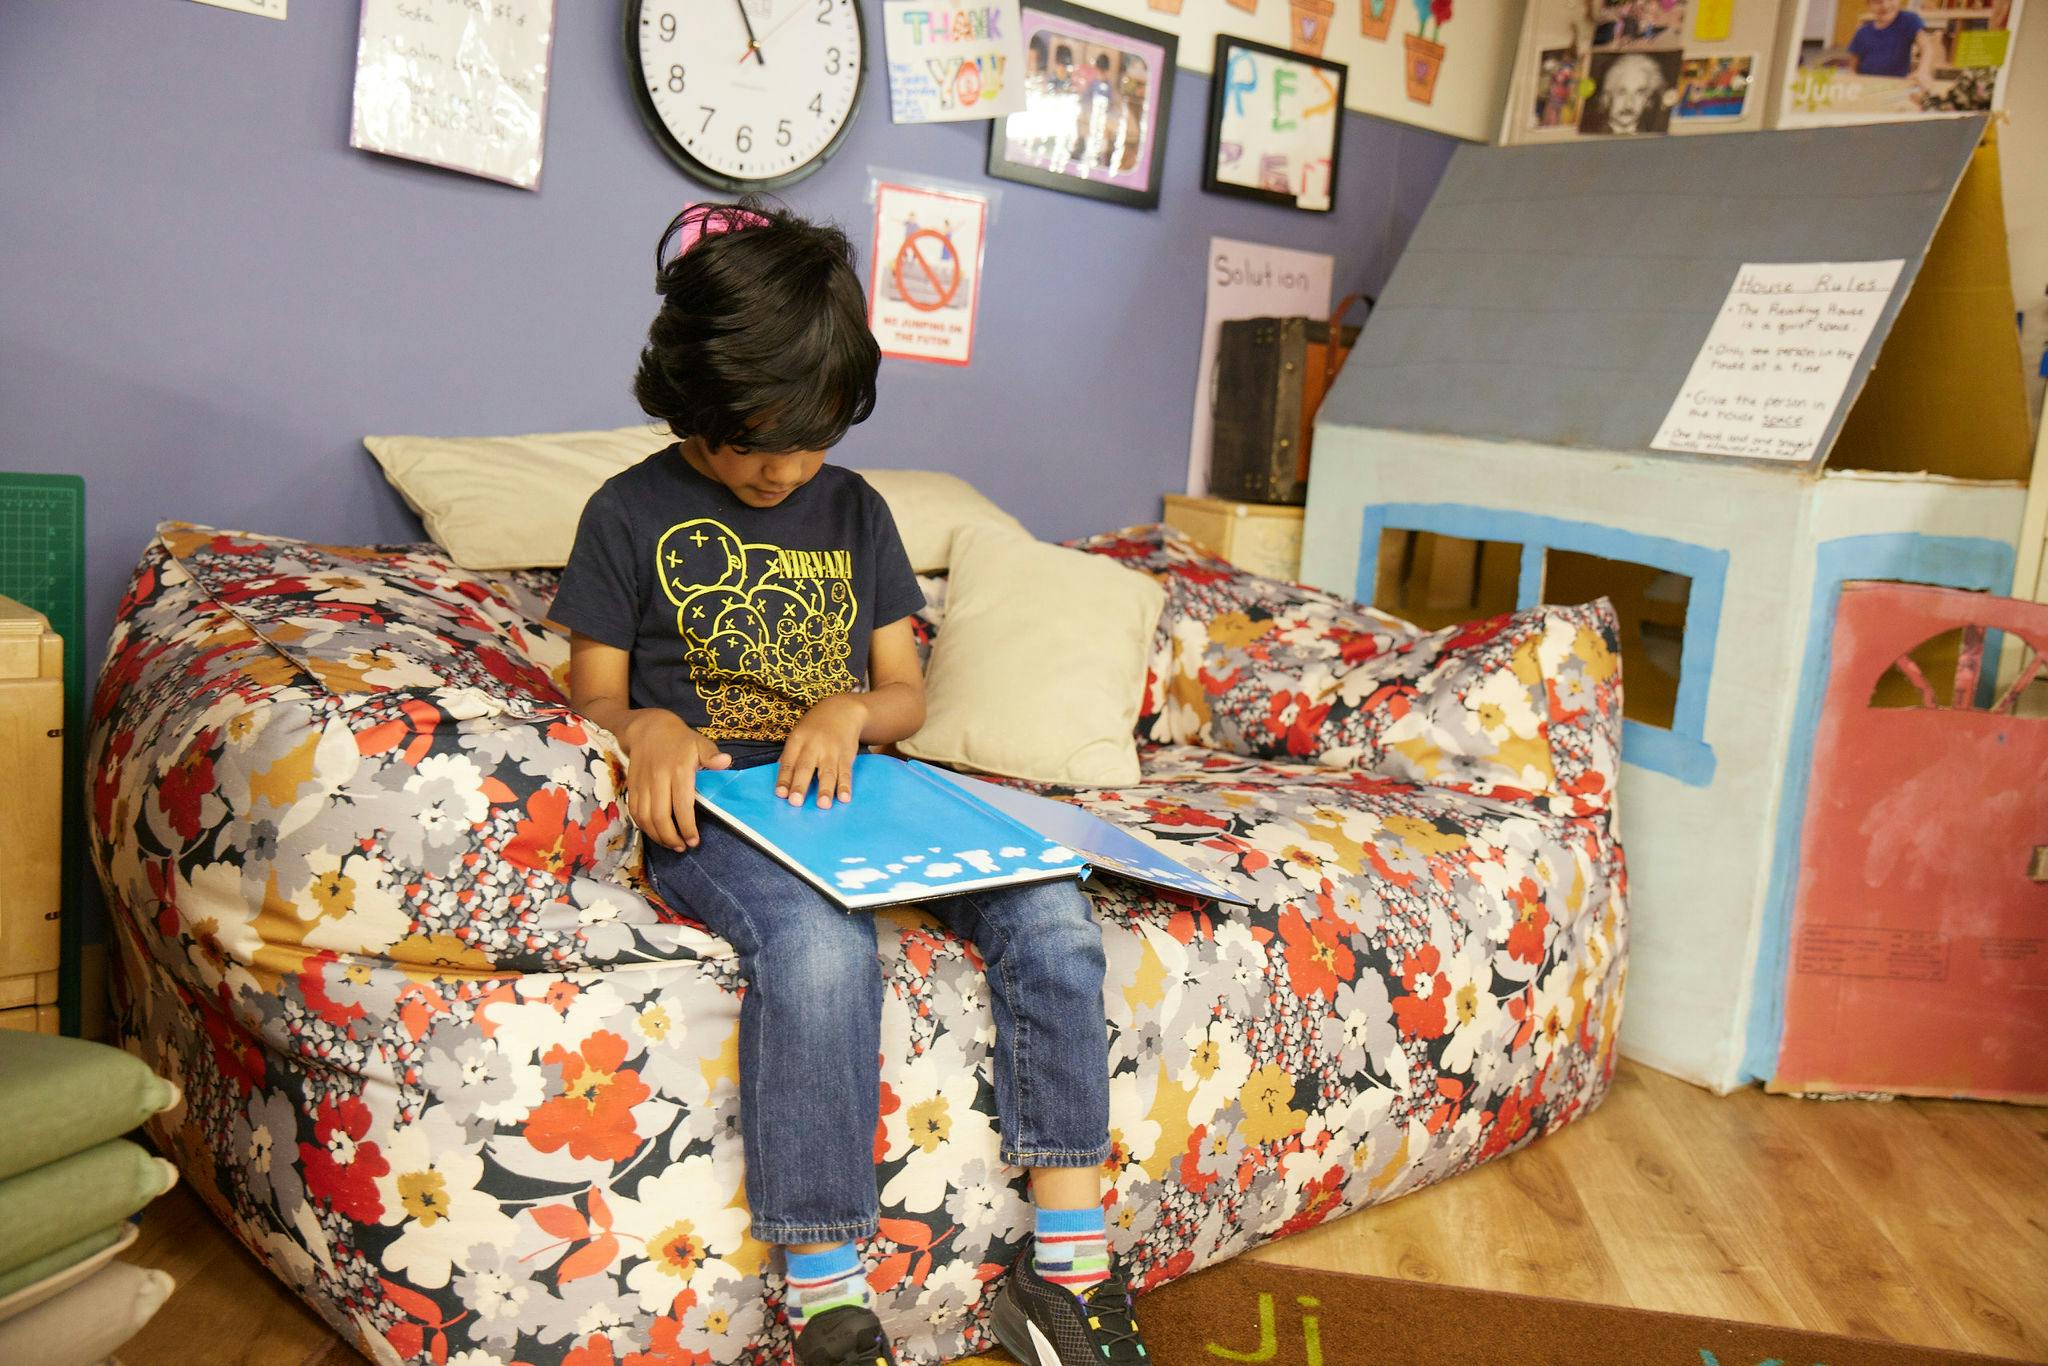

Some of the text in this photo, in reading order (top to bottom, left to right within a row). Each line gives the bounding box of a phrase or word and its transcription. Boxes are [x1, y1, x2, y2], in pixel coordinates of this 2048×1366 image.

[817, 0, 833, 25] 2
[903, 7, 1003, 45] THANK
[660, 13, 676, 42] 9
[825, 47, 840, 75] 3
[668, 64, 685, 93] 8
[808, 92, 823, 117] 4
[700, 106, 716, 133] 7
[776, 119, 792, 147] 5
[736, 125, 752, 153] 6
[1215, 255, 1310, 291] Solution
[1739, 272, 1879, 293] House Rules
[1737, 302, 1759, 316] The
[1769, 302, 1820, 318] Reading
[883, 317, 962, 333] NO JUMPING ON
[1742, 320, 1753, 330] is
[1761, 322, 1771, 330] a
[895, 332, 951, 346] THE FUTON
[1693, 390, 1728, 406] Give
[1763, 396, 1808, 411] person
[777, 550, 853, 579] NIRVANA
